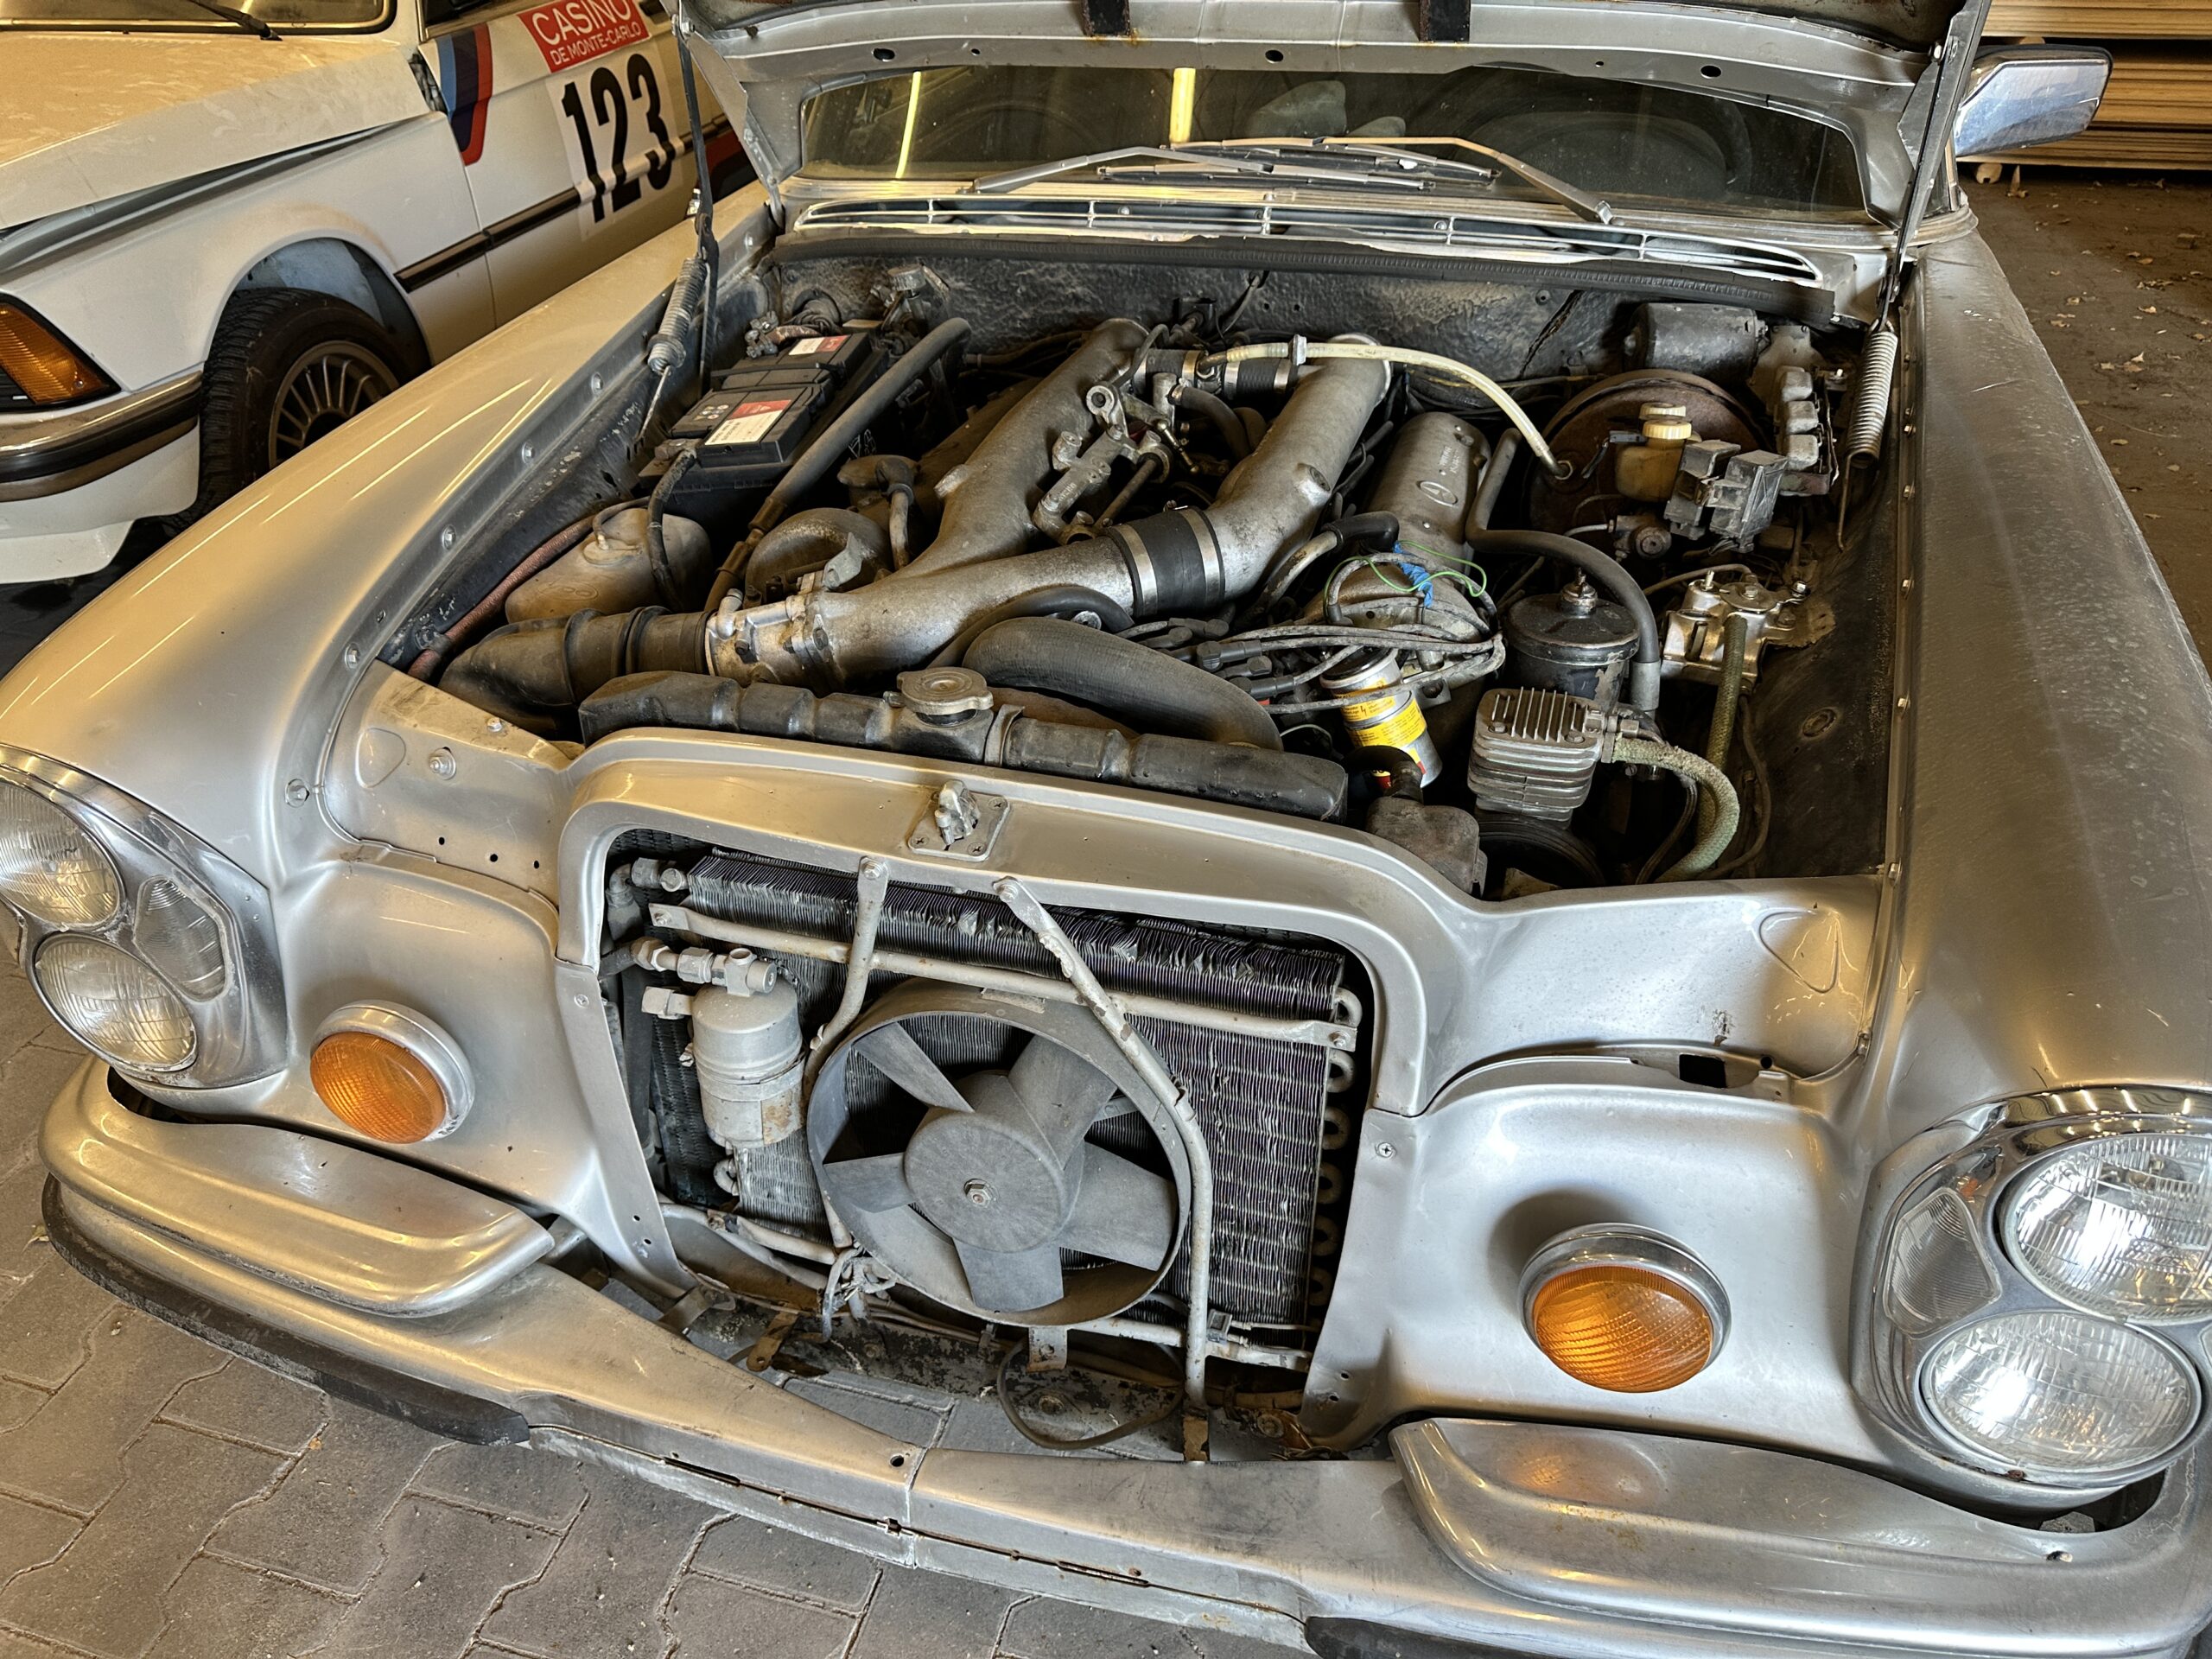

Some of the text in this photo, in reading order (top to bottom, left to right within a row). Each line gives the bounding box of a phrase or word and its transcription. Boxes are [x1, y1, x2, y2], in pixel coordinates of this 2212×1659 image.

[532, 0, 631, 45] CASINO
[550, 22, 641, 66] DE MONTE-CARLO
[562, 54, 676, 223] 123
